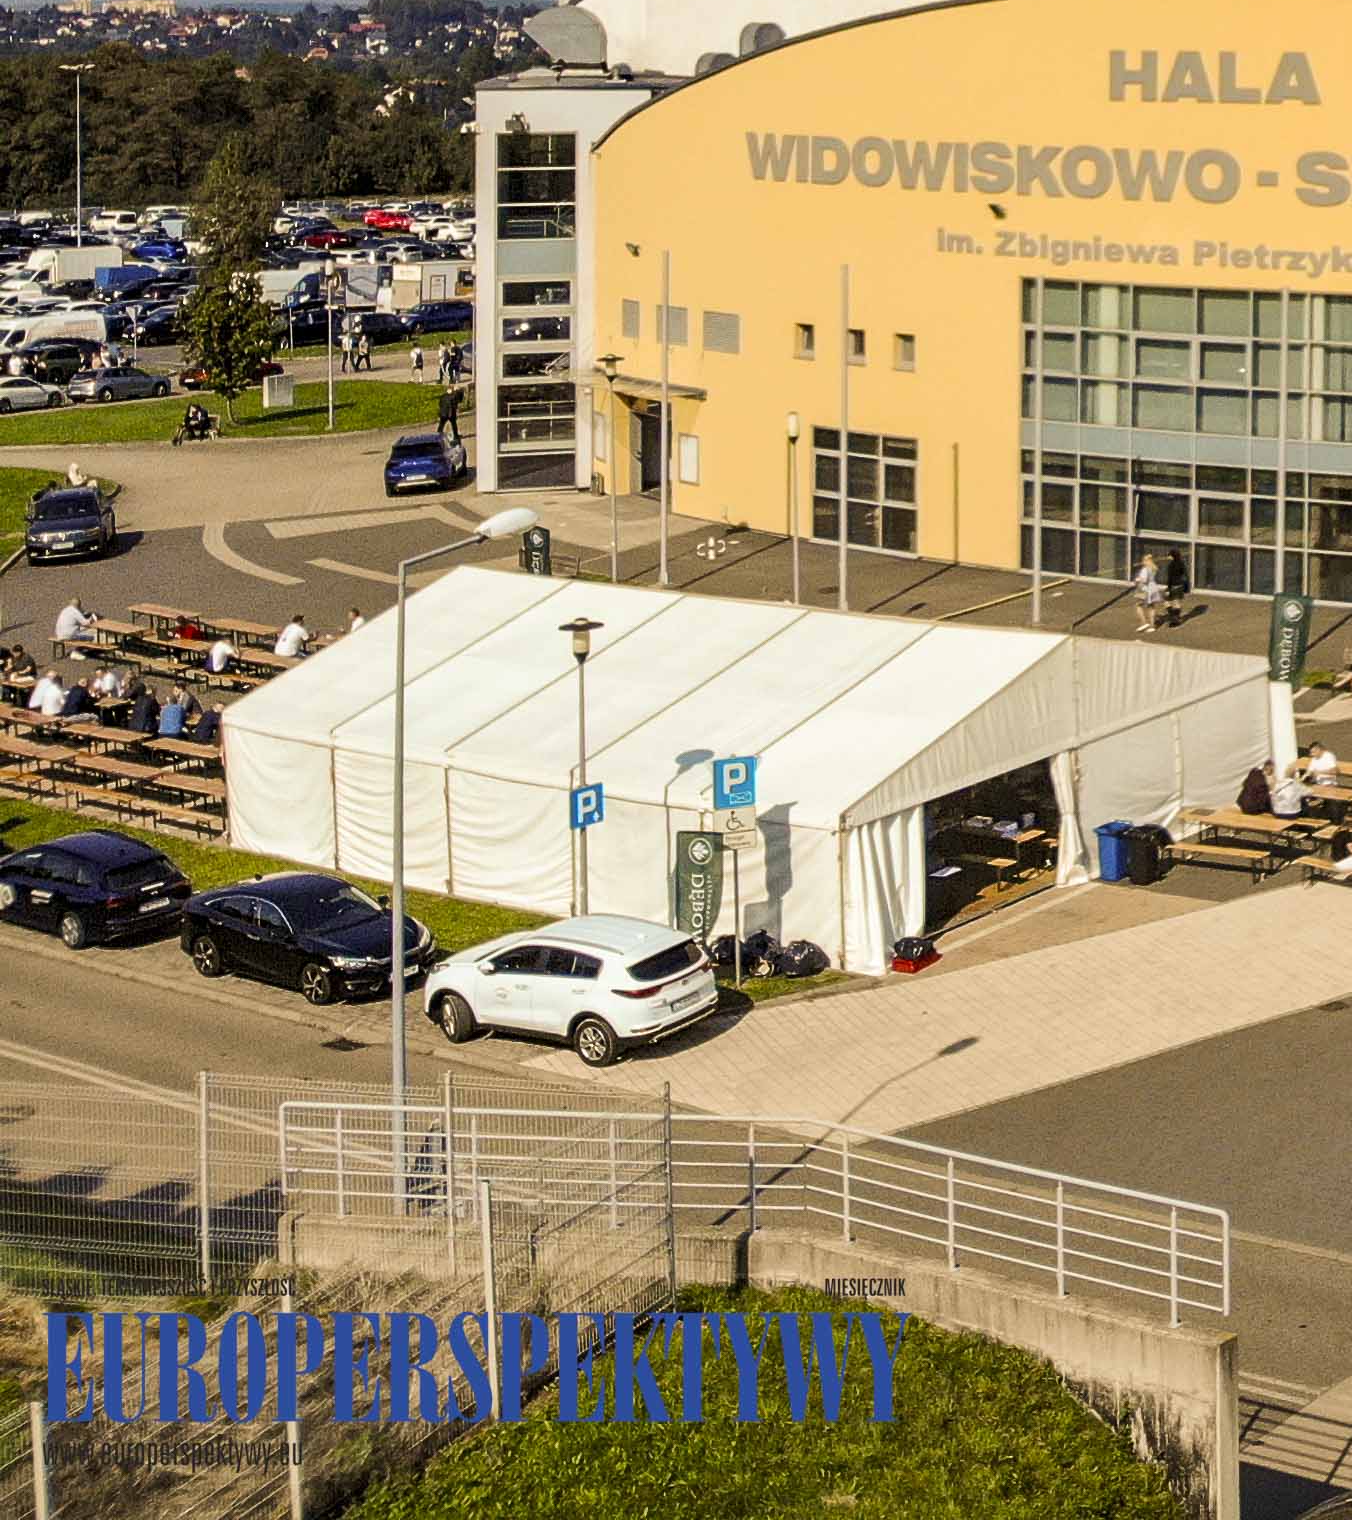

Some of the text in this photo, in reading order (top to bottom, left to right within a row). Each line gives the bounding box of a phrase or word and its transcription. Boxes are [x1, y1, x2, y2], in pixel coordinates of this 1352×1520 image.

[1110, 50, 1320, 103] HALA
[747, 131, 1241, 204] WIDOWISKOWO
[998, 232, 1178, 264] Zbigniewa
[722, 763, 746, 795] P
[577, 790, 597, 824] P
